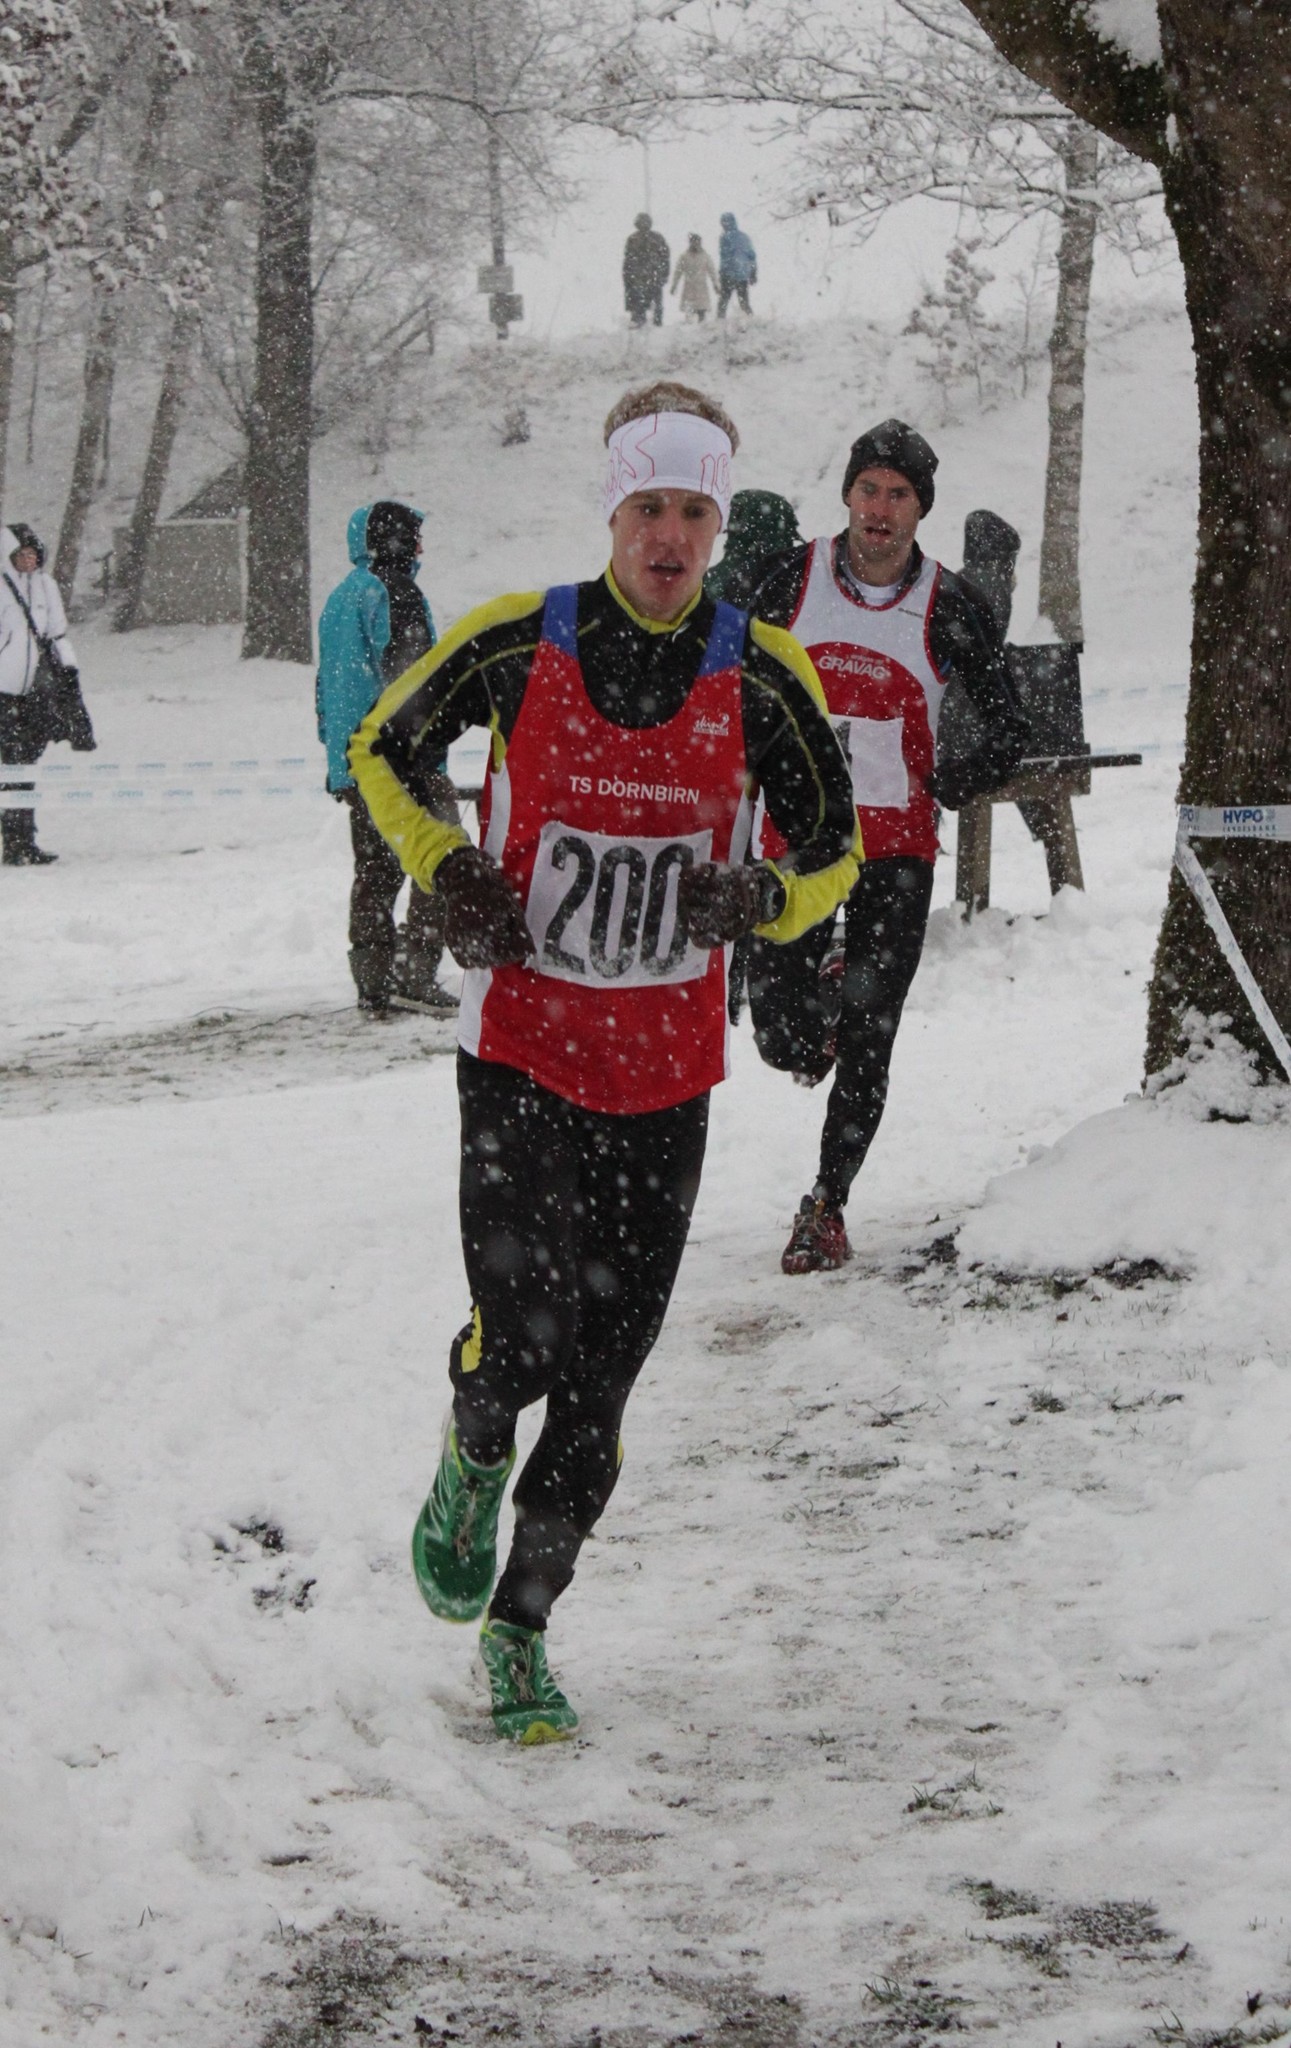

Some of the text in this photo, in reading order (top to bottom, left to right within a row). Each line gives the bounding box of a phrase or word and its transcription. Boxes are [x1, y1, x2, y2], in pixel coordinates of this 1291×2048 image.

[818, 655, 887, 680] GRAVAG
[569, 775, 700, 805] TS DORNBIRN
[1223, 808, 1264, 823] HYPO
[543, 835, 695, 979] 200
